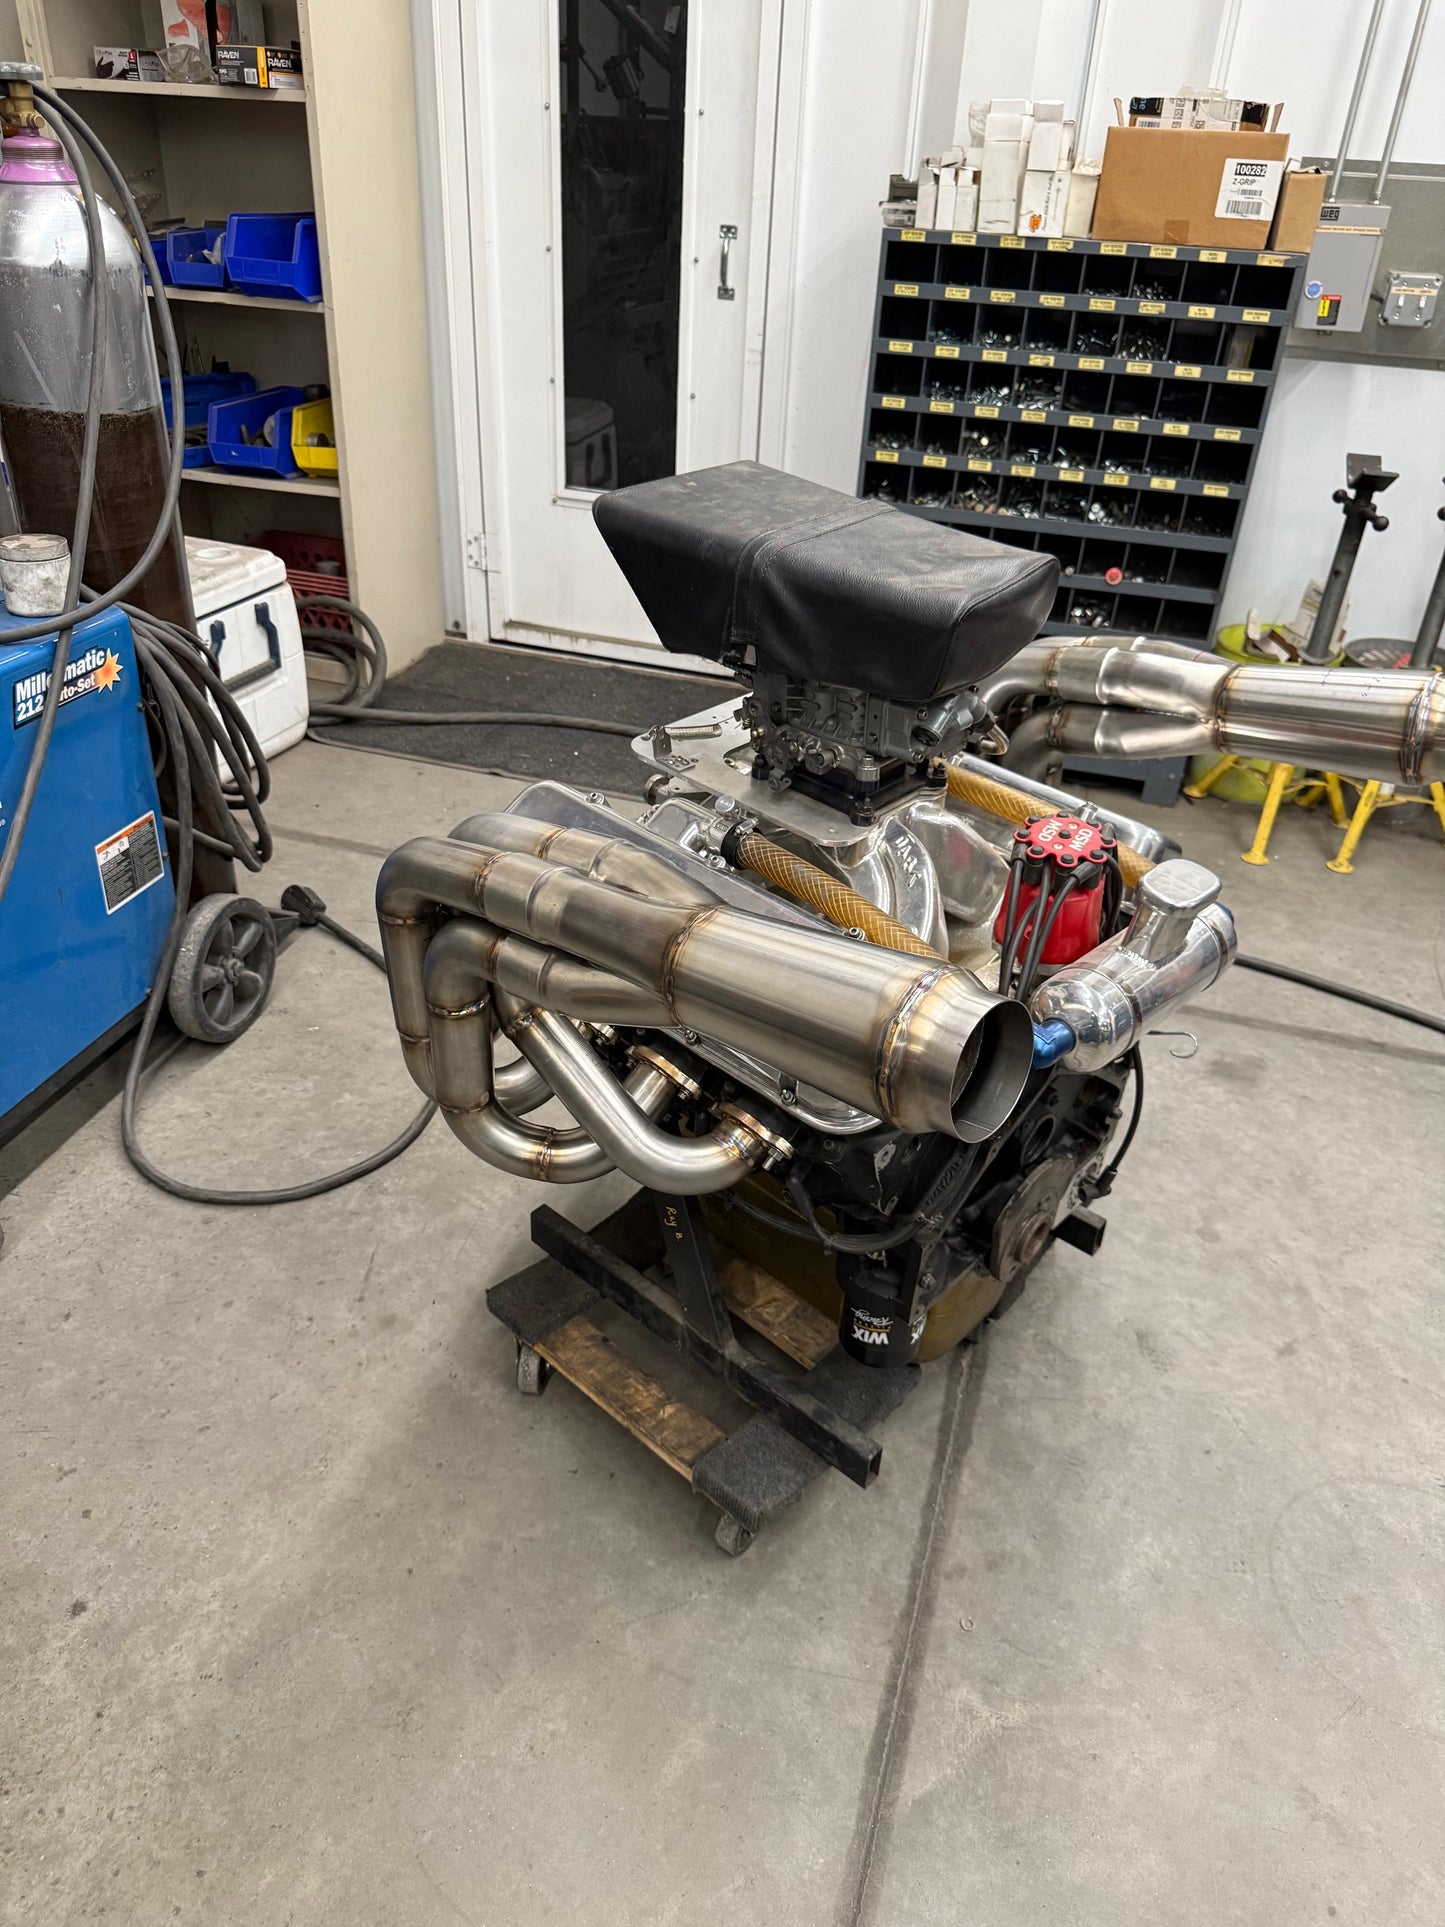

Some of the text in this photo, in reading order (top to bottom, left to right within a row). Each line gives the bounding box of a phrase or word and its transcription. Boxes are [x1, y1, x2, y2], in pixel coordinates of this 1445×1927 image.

[217, 50, 240, 59] RAVEN
[267, 58, 292, 68] RAVEN
[1236, 164, 1267, 176] 100282
[1232, 178, 1257, 186] Z-GRIP
[17, 695, 44, 722] 212
[1038, 819, 1063, 842] MSD
[1068, 828, 1094, 852] MSD
[850, 1307, 894, 1326] Racing
[851, 1325, 890, 1345] WIX
